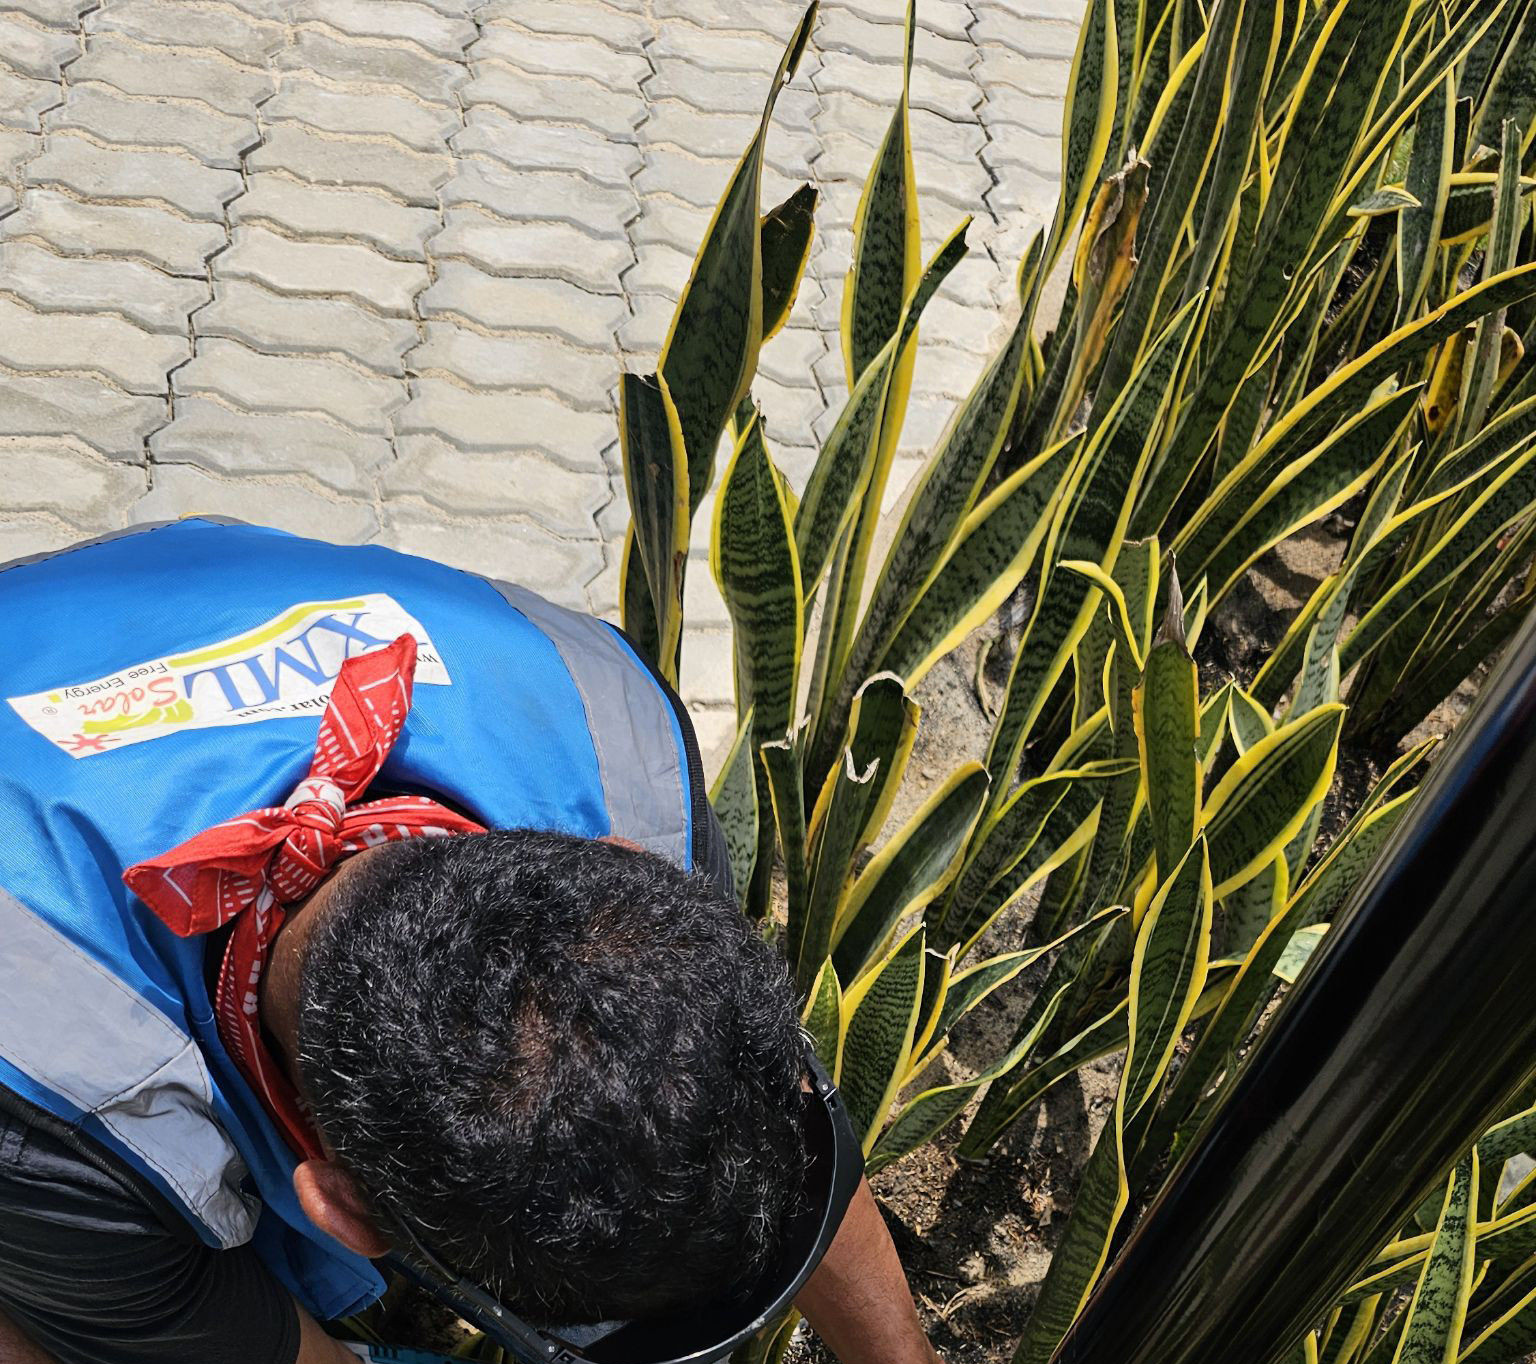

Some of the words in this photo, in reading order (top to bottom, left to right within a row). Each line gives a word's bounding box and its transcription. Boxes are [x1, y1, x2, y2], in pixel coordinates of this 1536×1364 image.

[128, 662, 168, 679] Free
[183, 612, 428, 712] XML
[64, 677, 125, 699] Energy
[78, 677, 178, 715] Solar
